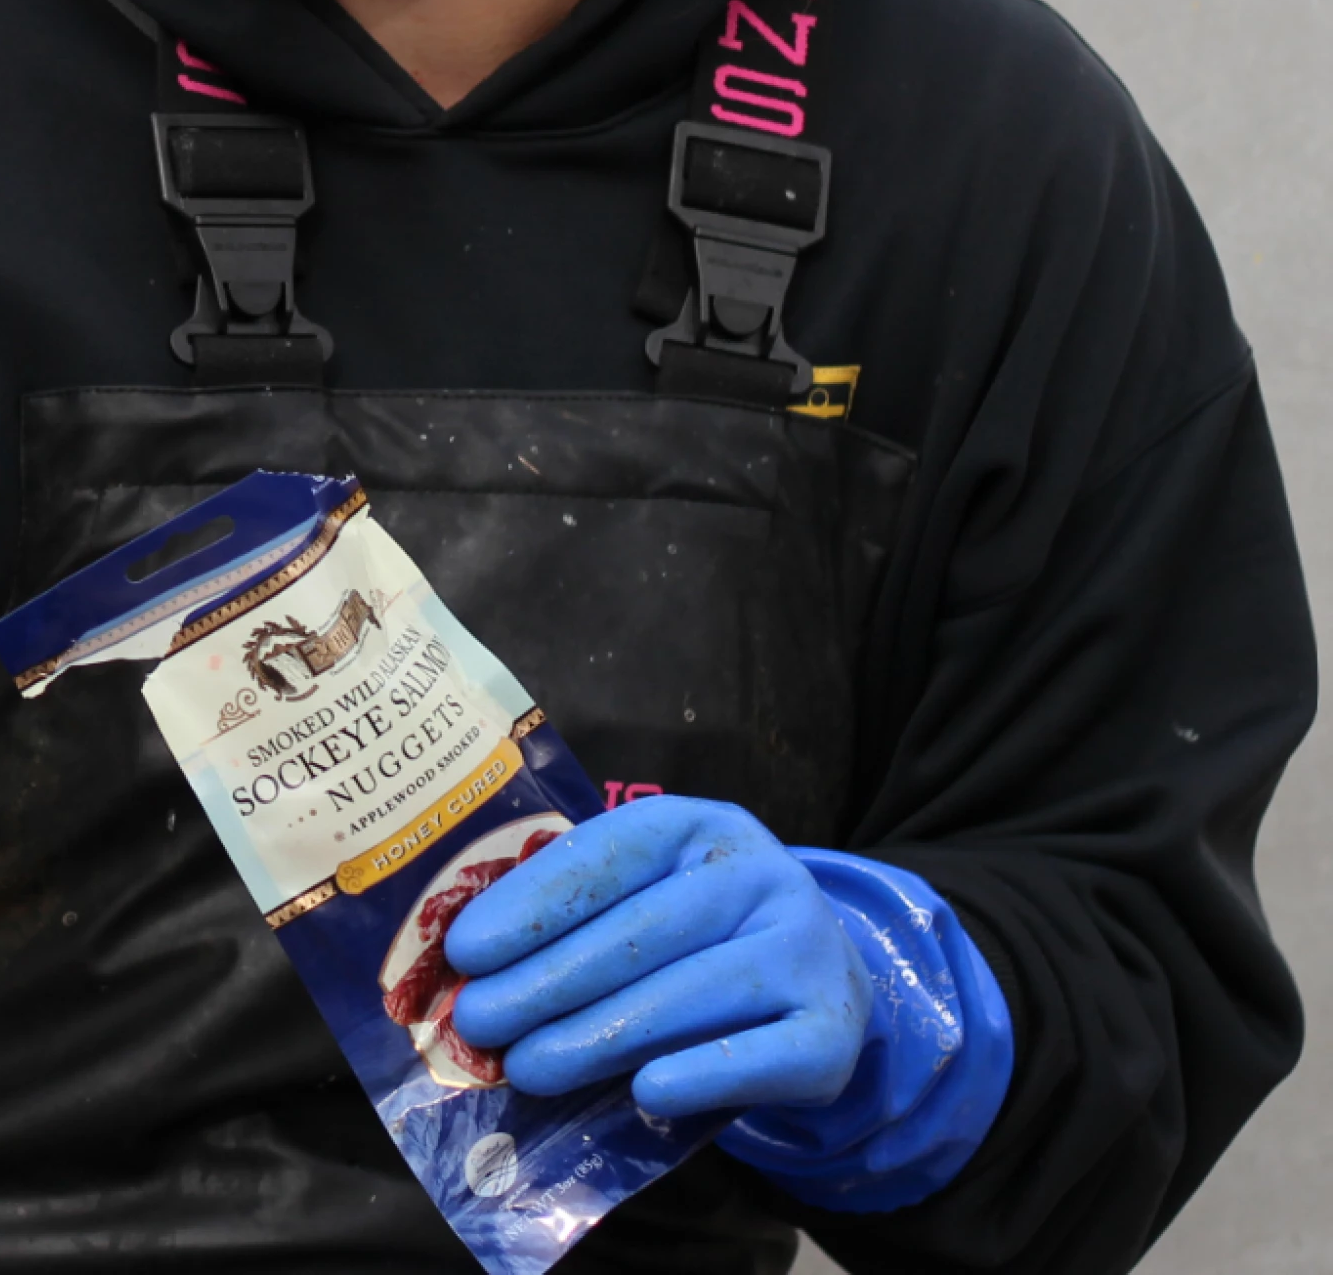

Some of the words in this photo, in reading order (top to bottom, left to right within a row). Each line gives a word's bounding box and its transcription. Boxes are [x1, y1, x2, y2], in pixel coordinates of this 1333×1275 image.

[232, 704, 393, 817] SOCKEYE
[247, 707, 335, 768] SMOKED
[334, 670, 386, 712] WILD
[326, 693, 464, 812] NUGGETS
[349, 768, 436, 835] APPLEWOOD
[436, 725, 480, 772] SMOKED
[372, 811, 443, 871] HONEY
[447, 759, 508, 815] CURED
